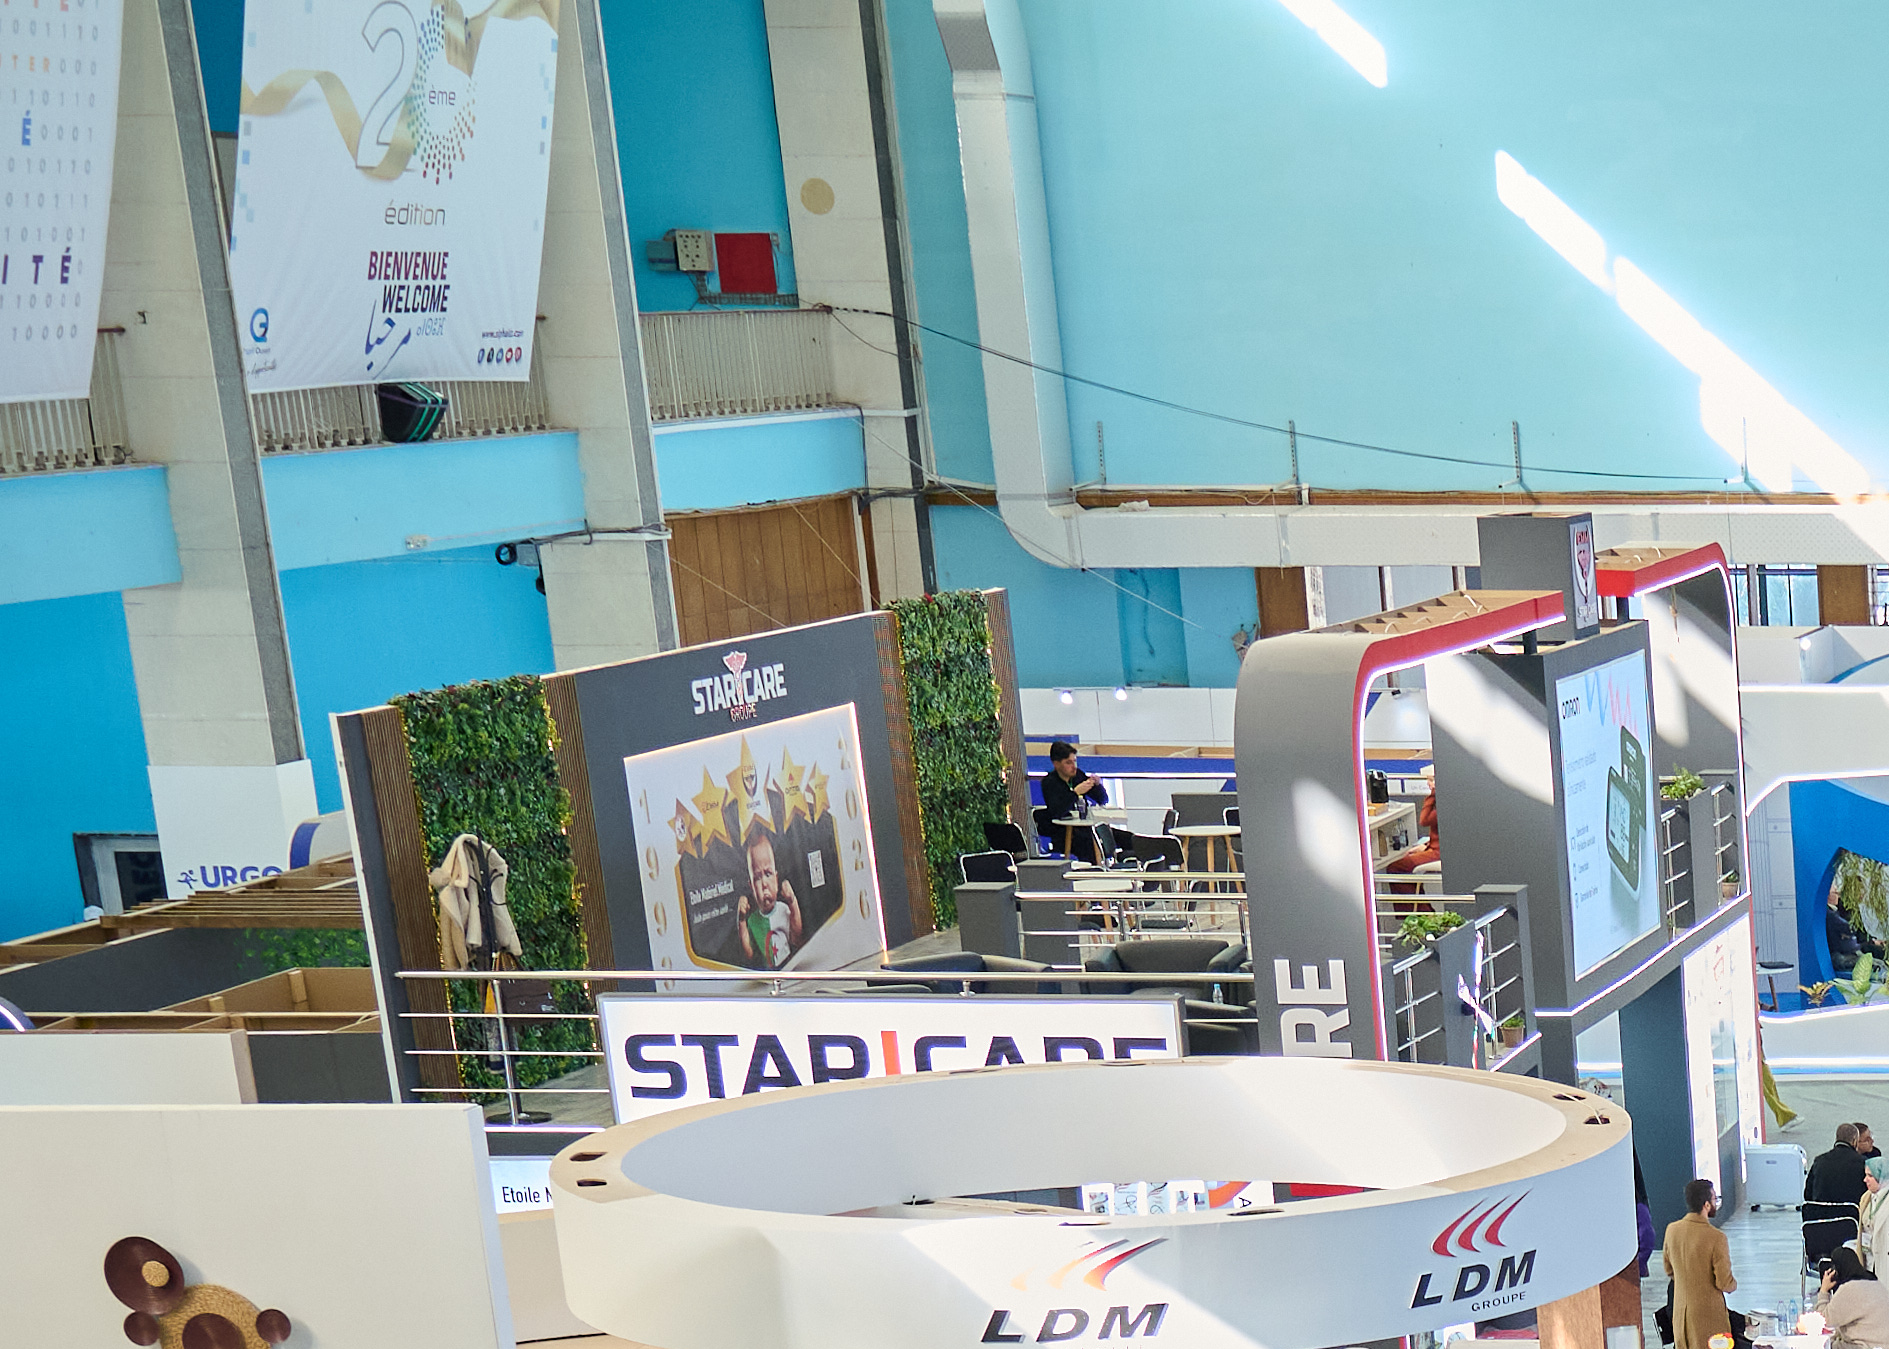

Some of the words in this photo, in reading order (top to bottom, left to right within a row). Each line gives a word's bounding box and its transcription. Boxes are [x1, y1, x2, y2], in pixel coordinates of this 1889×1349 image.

[385, 199, 446, 226] édition
[367, 251, 449, 281] BIENVENUE
[382, 285, 450, 313] WELCOME
[502, 1186, 540, 1203] Etoile
[1408, 1249, 1537, 1310] LDM
[1470, 1292, 1527, 1312] GROUPE
[981, 1302, 1169, 1344] LDM
